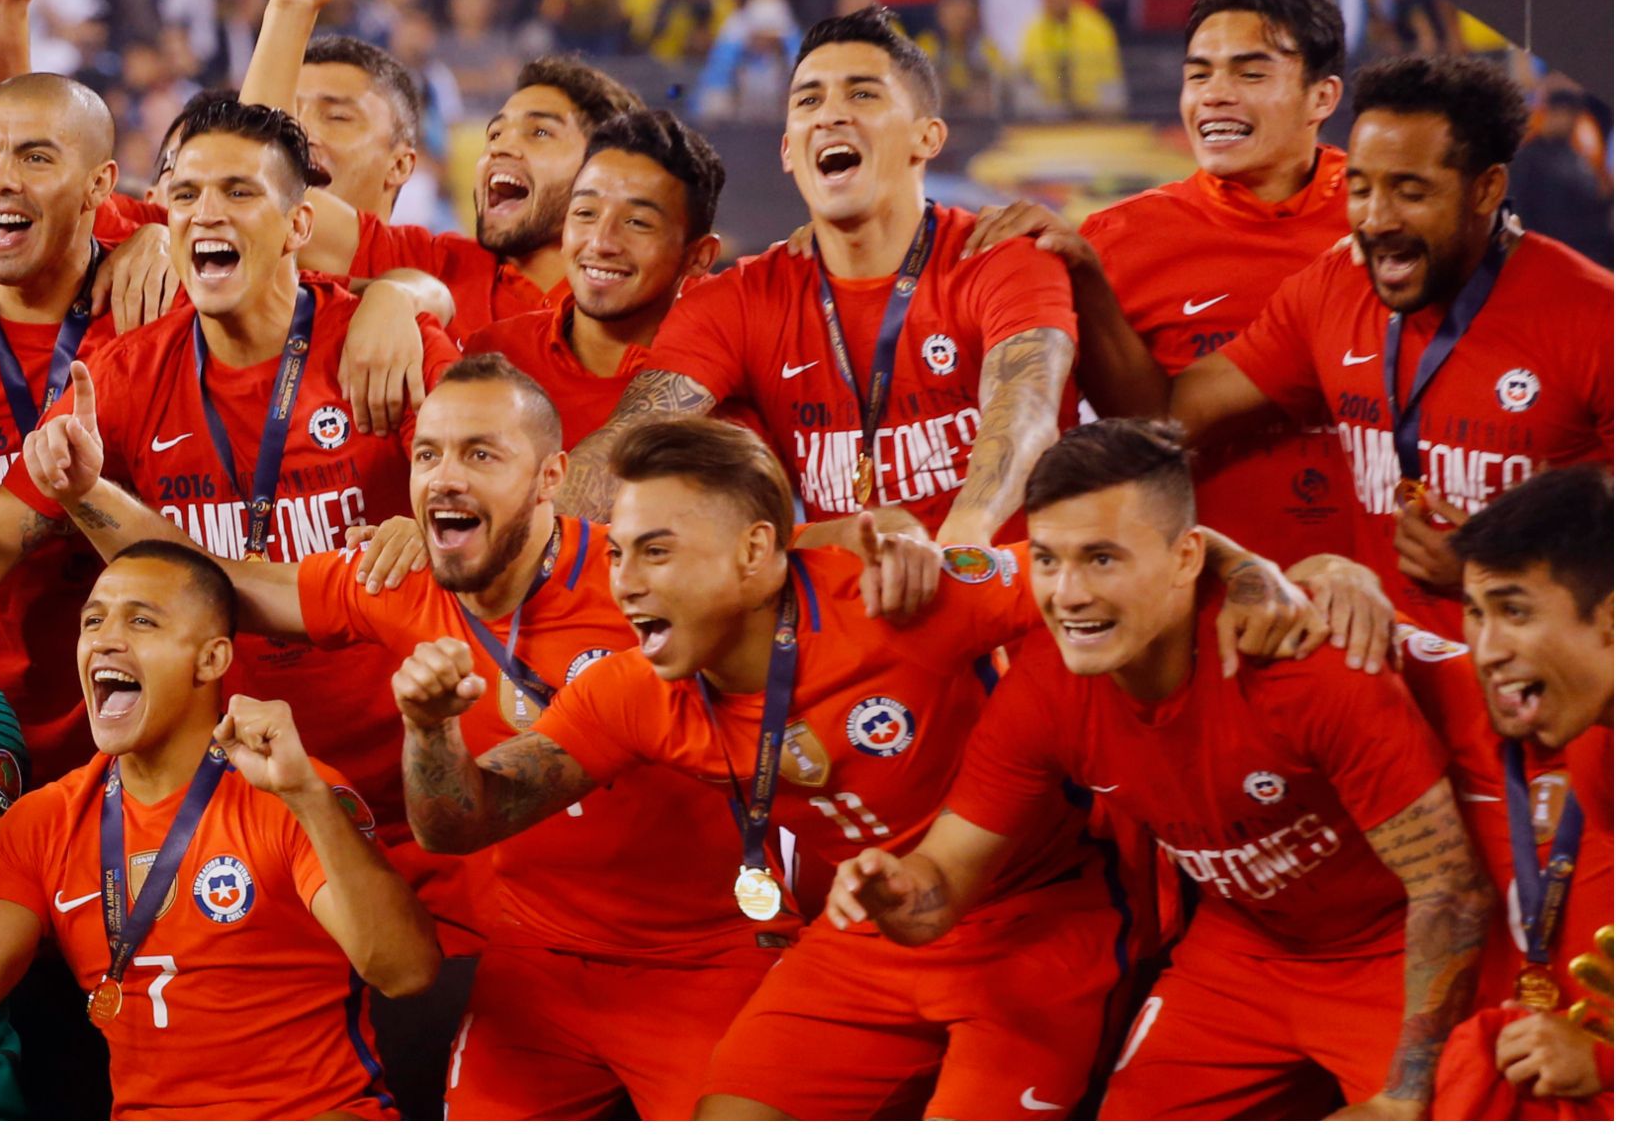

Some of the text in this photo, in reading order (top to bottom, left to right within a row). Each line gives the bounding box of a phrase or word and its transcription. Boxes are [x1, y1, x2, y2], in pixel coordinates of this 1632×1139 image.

[1338, 392, 1382, 424] 2016
[157, 474, 216, 501] 2016
[160, 486, 368, 564] CAMPONES
[808, 792, 893, 842] 11
[193, 856, 254, 896] FEDERACION DE FUTBOL
[106, 869, 116, 932] COPA AMERICA
[212, 908, 246, 923] DE CHILE
[133, 954, 179, 1028] 7
